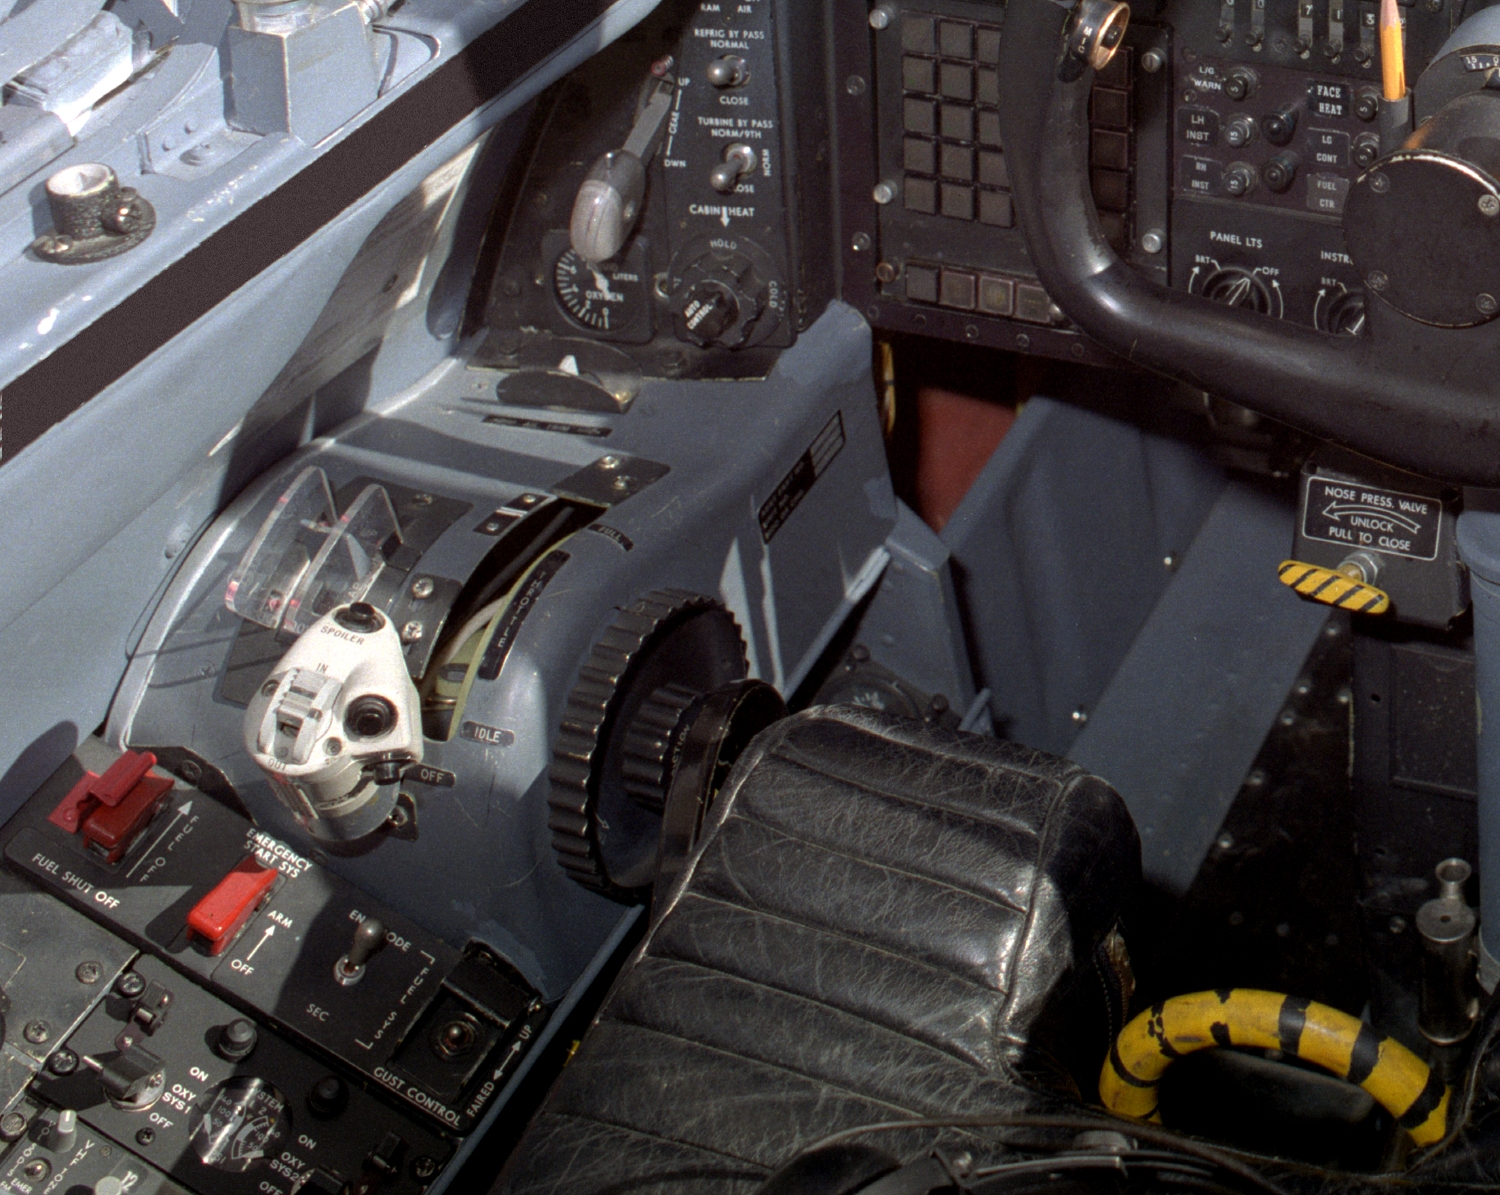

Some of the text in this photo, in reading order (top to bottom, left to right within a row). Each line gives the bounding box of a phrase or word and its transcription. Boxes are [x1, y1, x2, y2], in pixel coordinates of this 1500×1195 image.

[695, 29, 764, 39] REFRIG BY PASS
[710, 40, 749, 50] NORMAL
[678, 78, 690, 86] UP
[719, 96, 749, 105] CLOSE
[1317, 85, 1341, 99] FACE
[1319, 102, 1342, 116] HEAT
[669, 112, 680, 135] GEAR
[698, 116, 773, 128] TURBINE BY PASS
[711, 129, 762, 139] NORM/9TH
[664, 159, 686, 168] DWN
[762, 149, 771, 177] NORM
[689, 204, 755, 217] CABIN HEAT
[1210, 231, 1263, 249] PANEL LTS
[1261, 266, 1279, 276] OFF
[1325, 486, 1428, 514] NOSE PRESS. VALVE
[1351, 515, 1394, 533] UNLOCK
[1329, 526, 1411, 551] PULL TO CLOSE
[320, 625, 365, 646] SPOILER
[474, 727, 501, 743] IDLE
[420, 767, 444, 783] OFF
[246, 828, 312, 871] EMERGENCY
[244, 840, 300, 879] START SYS
[32, 853, 120, 909] FUEL SHUT OFF
[267, 909, 293, 929] ARM
[230, 959, 254, 976] OFF
[306, 1004, 329, 1022] SEC
[519, 1025, 533, 1040] UP
[189, 1066, 209, 1083] ON
[171, 1083, 198, 1101] OXY
[373, 1067, 461, 1126] GUST CONTROL
[466, 1081, 495, 1118] FAIRED
[149, 1112, 174, 1130] OFF
